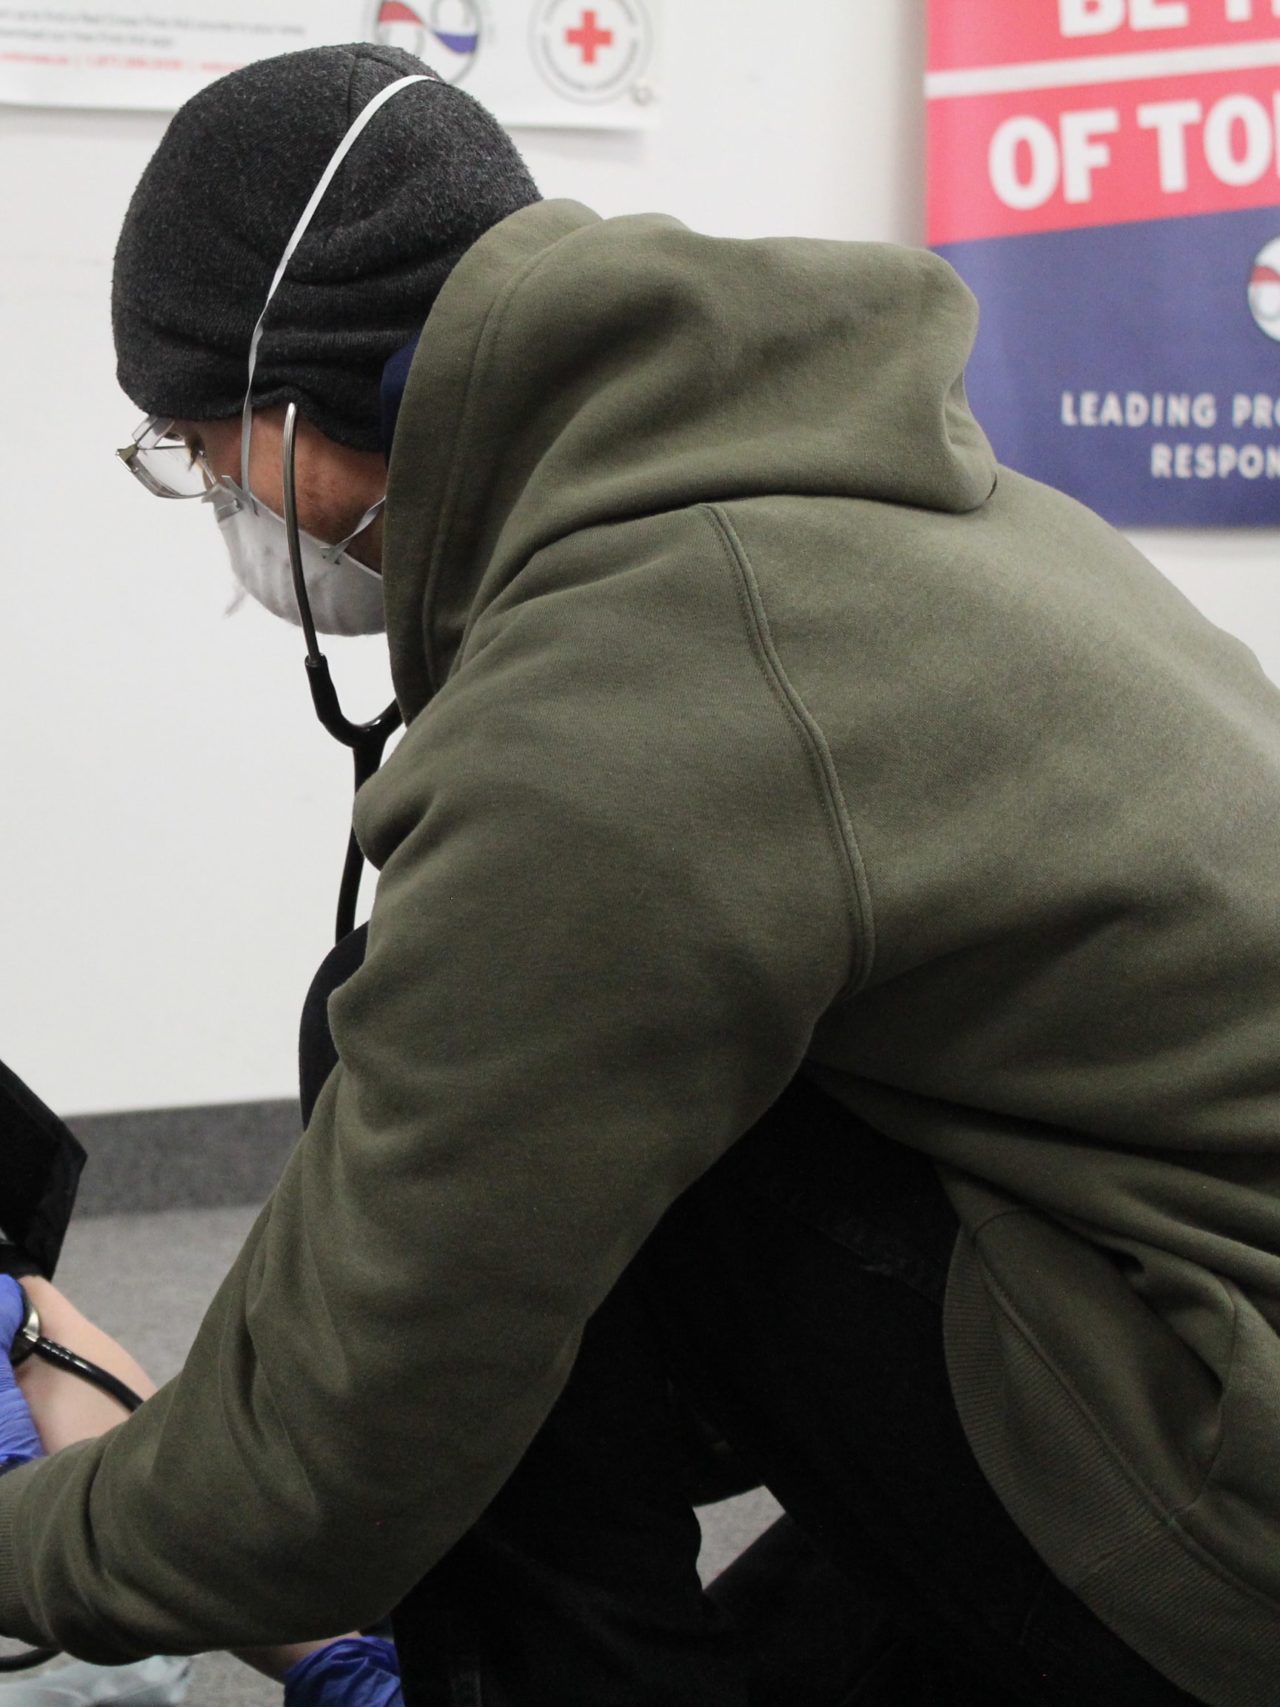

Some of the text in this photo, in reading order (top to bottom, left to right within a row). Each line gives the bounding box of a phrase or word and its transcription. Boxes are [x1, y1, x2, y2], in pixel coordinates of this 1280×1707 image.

[988, 92, 1280, 210] OF TO
[1061, 391, 1280, 429] LEADING PR
